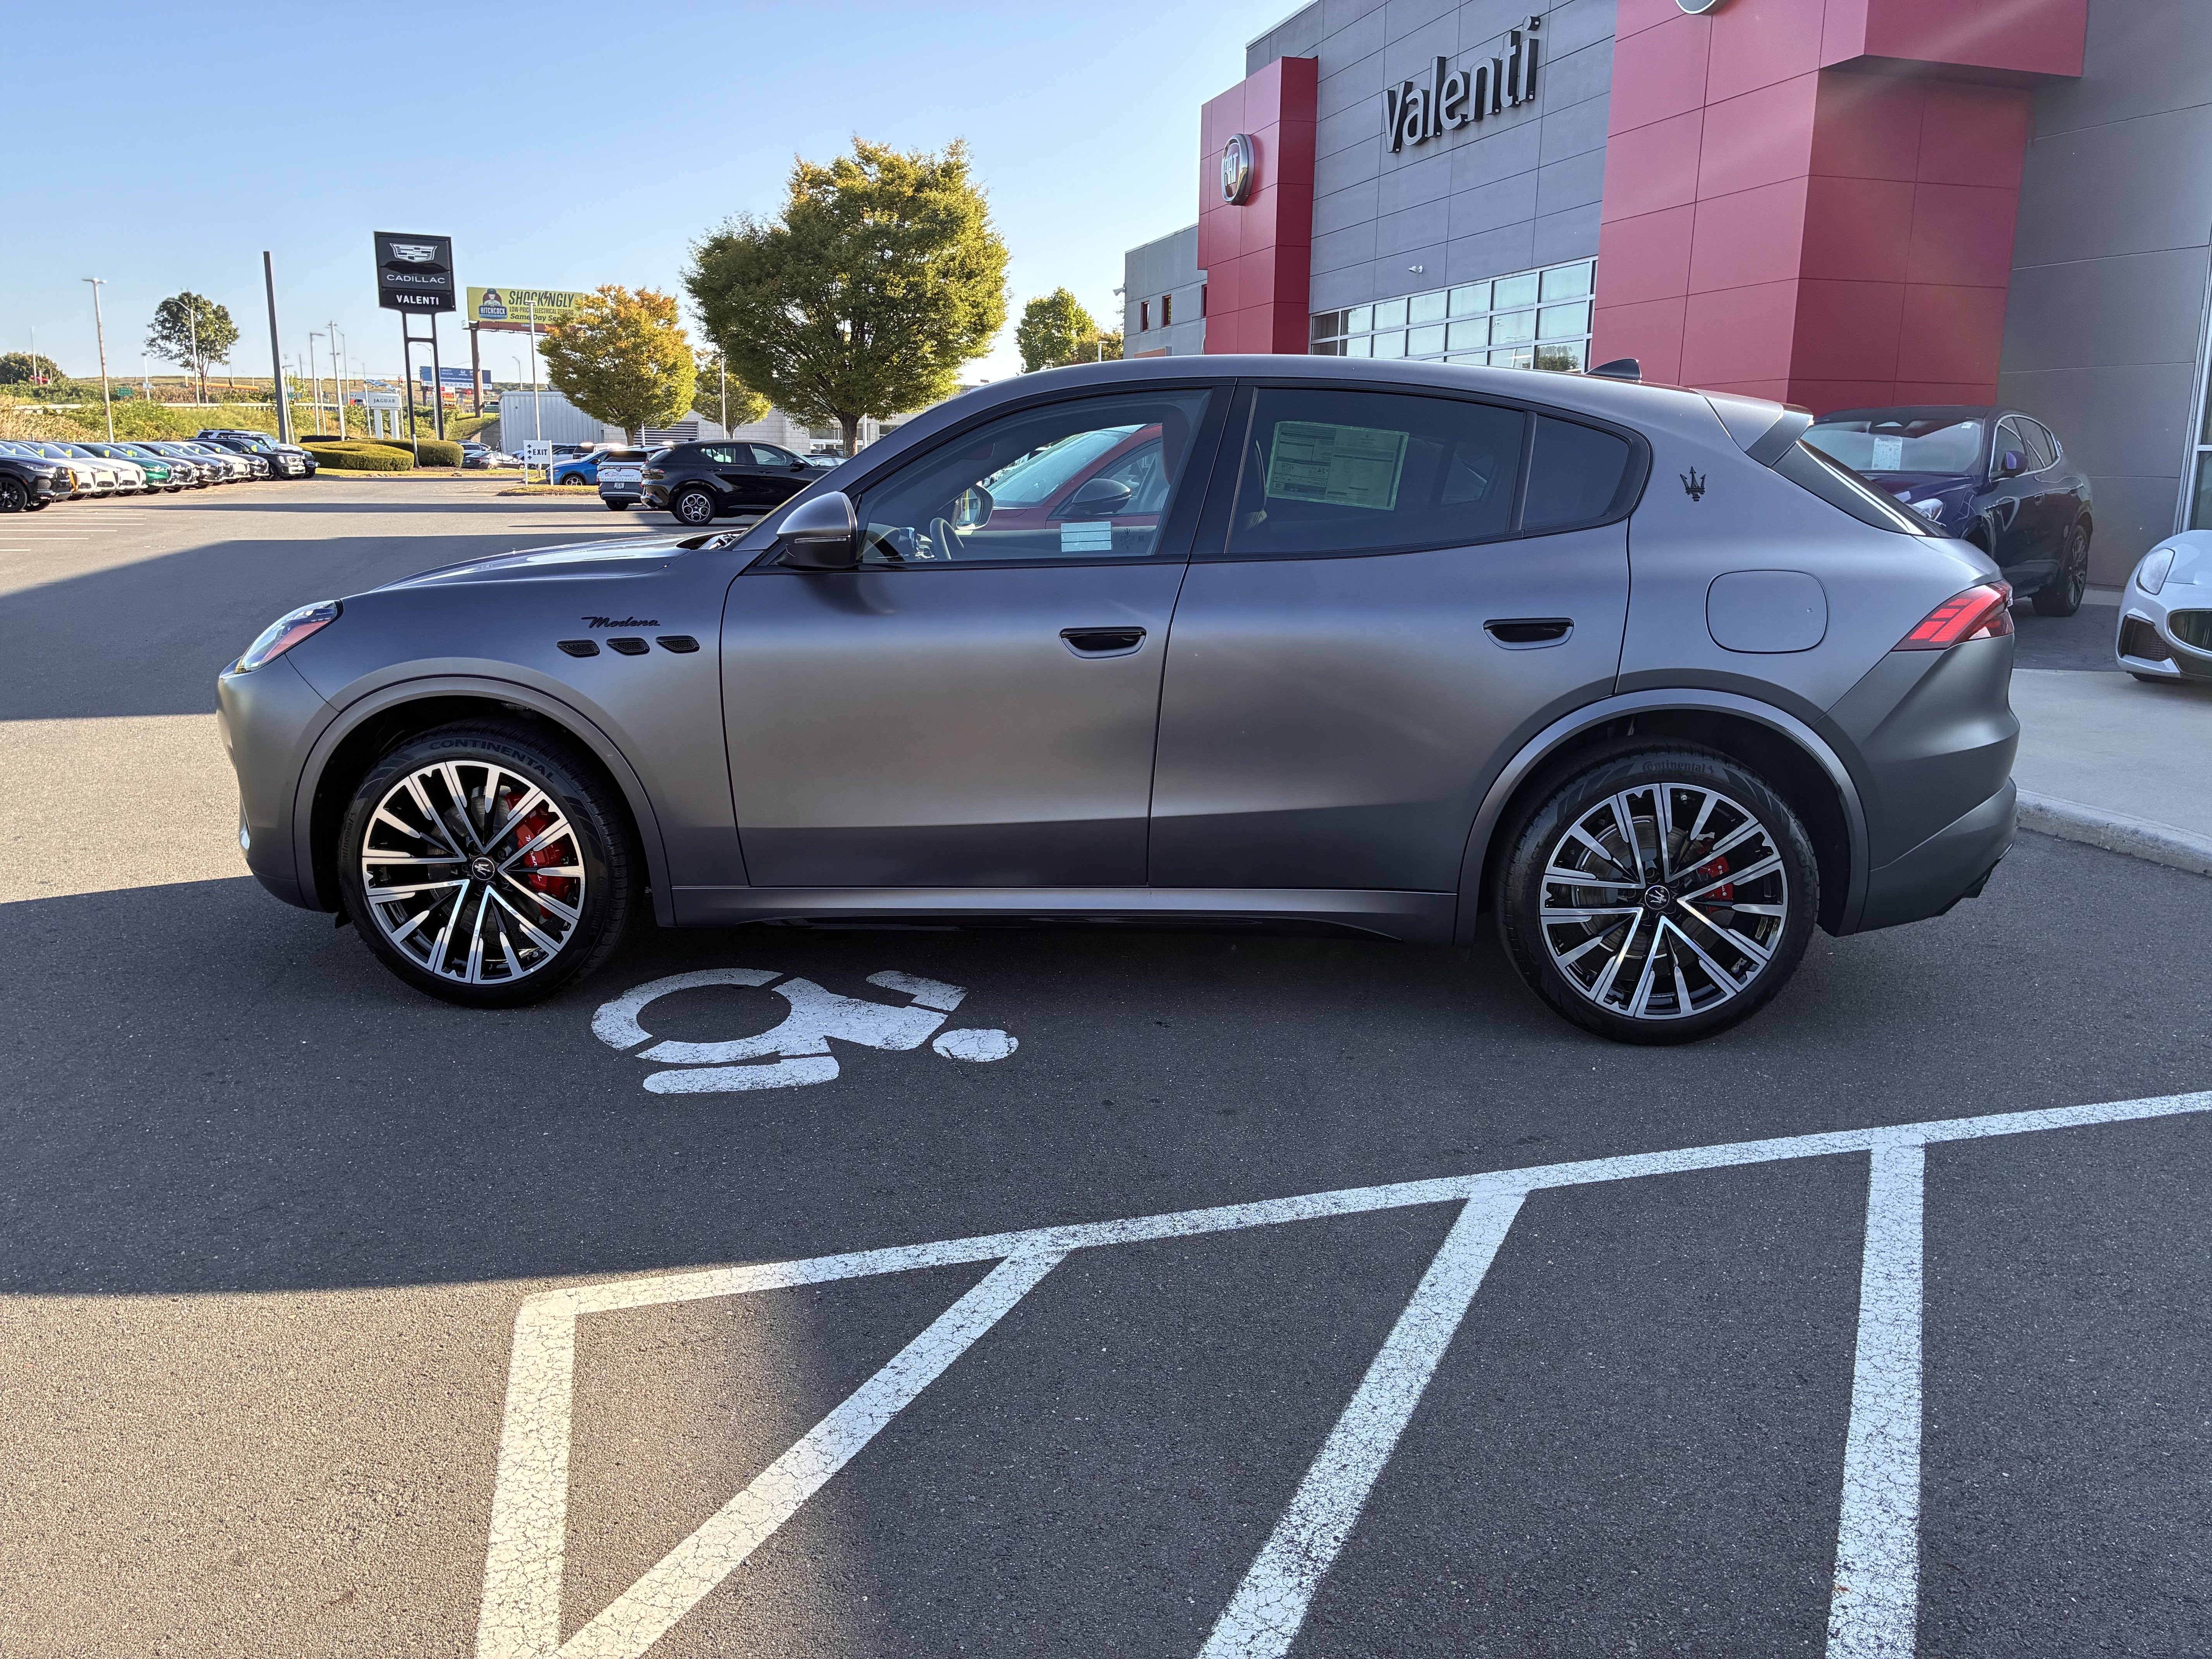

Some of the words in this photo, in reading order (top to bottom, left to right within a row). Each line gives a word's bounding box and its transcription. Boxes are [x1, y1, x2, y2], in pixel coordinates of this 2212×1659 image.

[1382, 15, 1540, 153] Valenti
[386, 274, 445, 283] CADILLAC
[396, 294, 439, 305] VALENTI
[581, 616, 660, 629] Modena
[429, 739, 554, 783] CONTINENTAL
[1642, 759, 1705, 773] Continental
